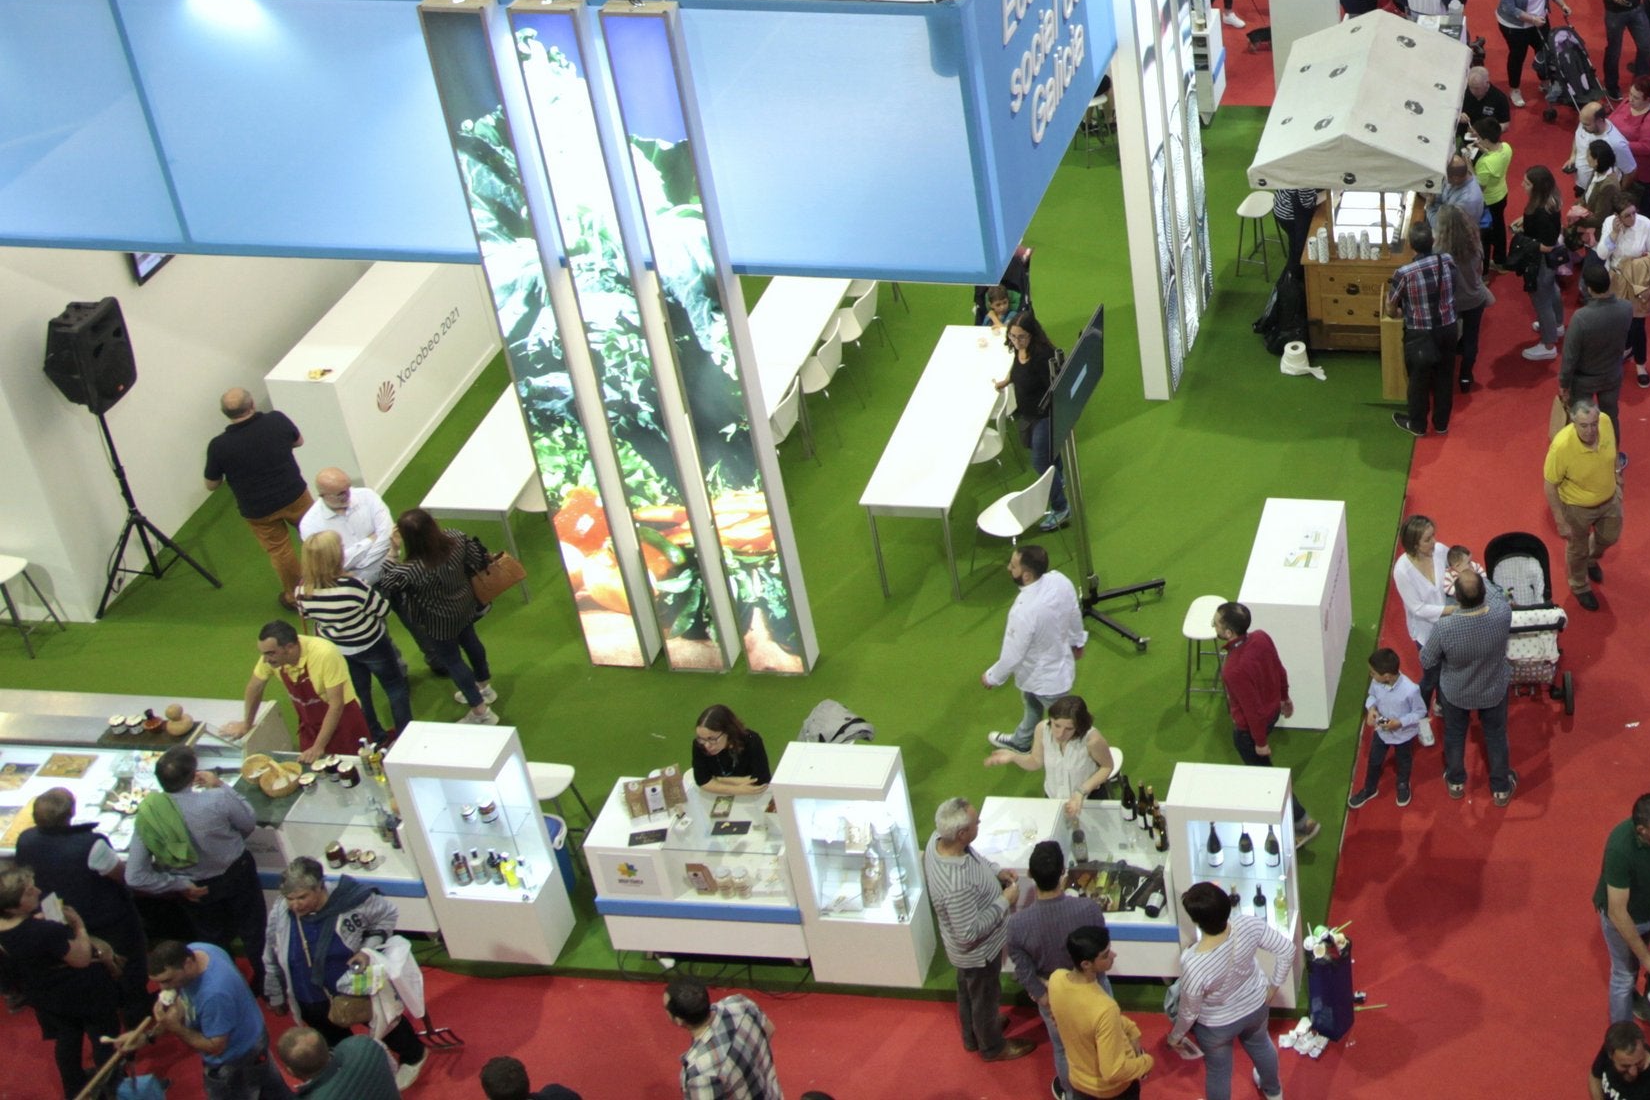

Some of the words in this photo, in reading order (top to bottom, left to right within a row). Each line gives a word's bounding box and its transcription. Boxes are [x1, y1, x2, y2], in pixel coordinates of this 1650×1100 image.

[1031, 23, 1085, 144] Galicia
[396, 332, 441, 389] Xacobeo
[440, 306, 461, 336] 2021
[341, 912, 363, 933] 86
